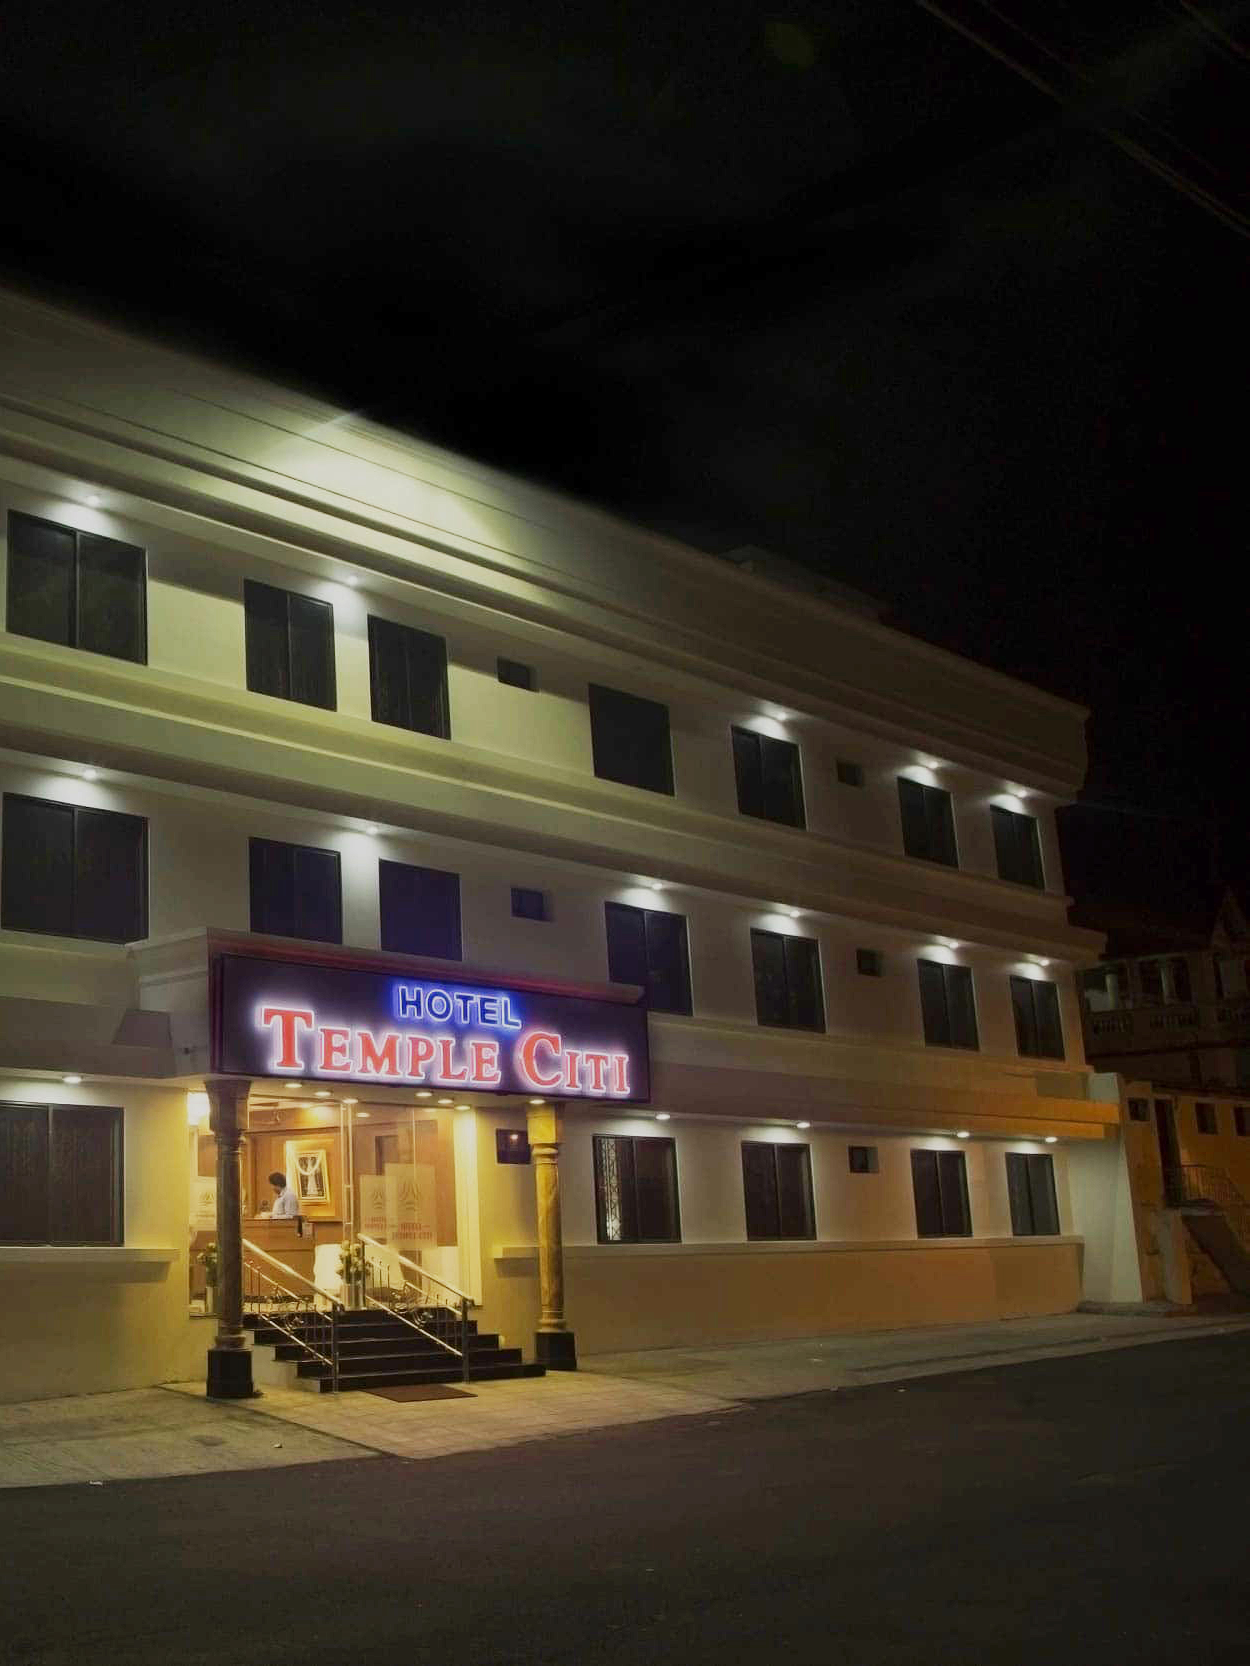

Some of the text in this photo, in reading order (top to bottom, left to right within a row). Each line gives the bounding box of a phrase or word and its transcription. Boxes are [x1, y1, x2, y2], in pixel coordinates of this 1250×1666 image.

[397, 985, 522, 1030] HOTEL
[261, 1006, 631, 1095] TEMPLE CITI
